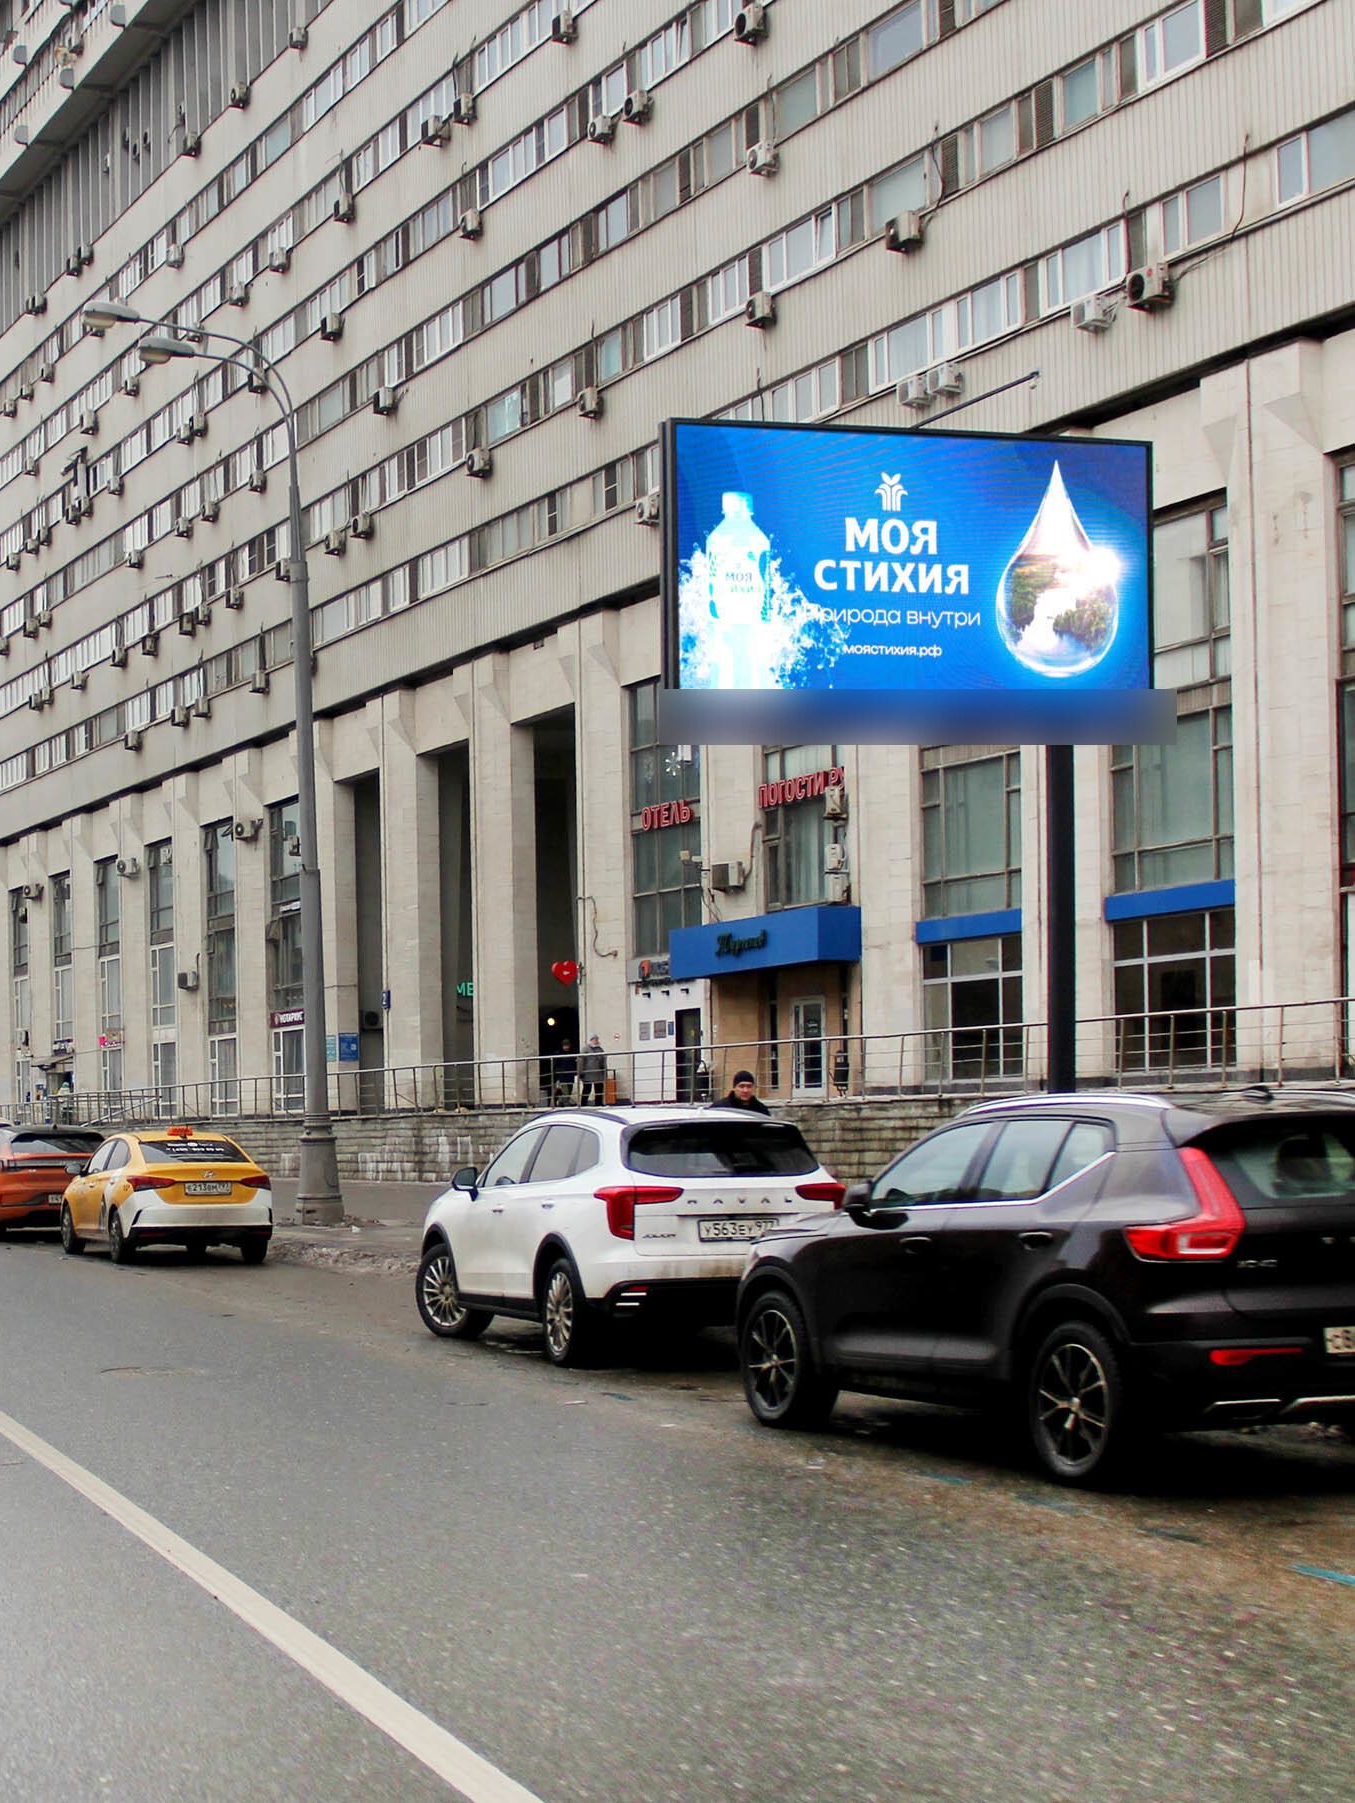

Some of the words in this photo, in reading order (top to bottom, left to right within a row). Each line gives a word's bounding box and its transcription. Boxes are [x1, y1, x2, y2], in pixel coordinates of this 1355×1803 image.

[845, 516, 938, 555] МОЯ
[813, 559, 970, 595] СТИХИЯ
[807, 607, 901, 627] рирода
[906, 610, 981, 629] внутри
[844, 644, 943, 658] моястихия.рф
[641, 799, 693, 831] ОТЕЛЬ
